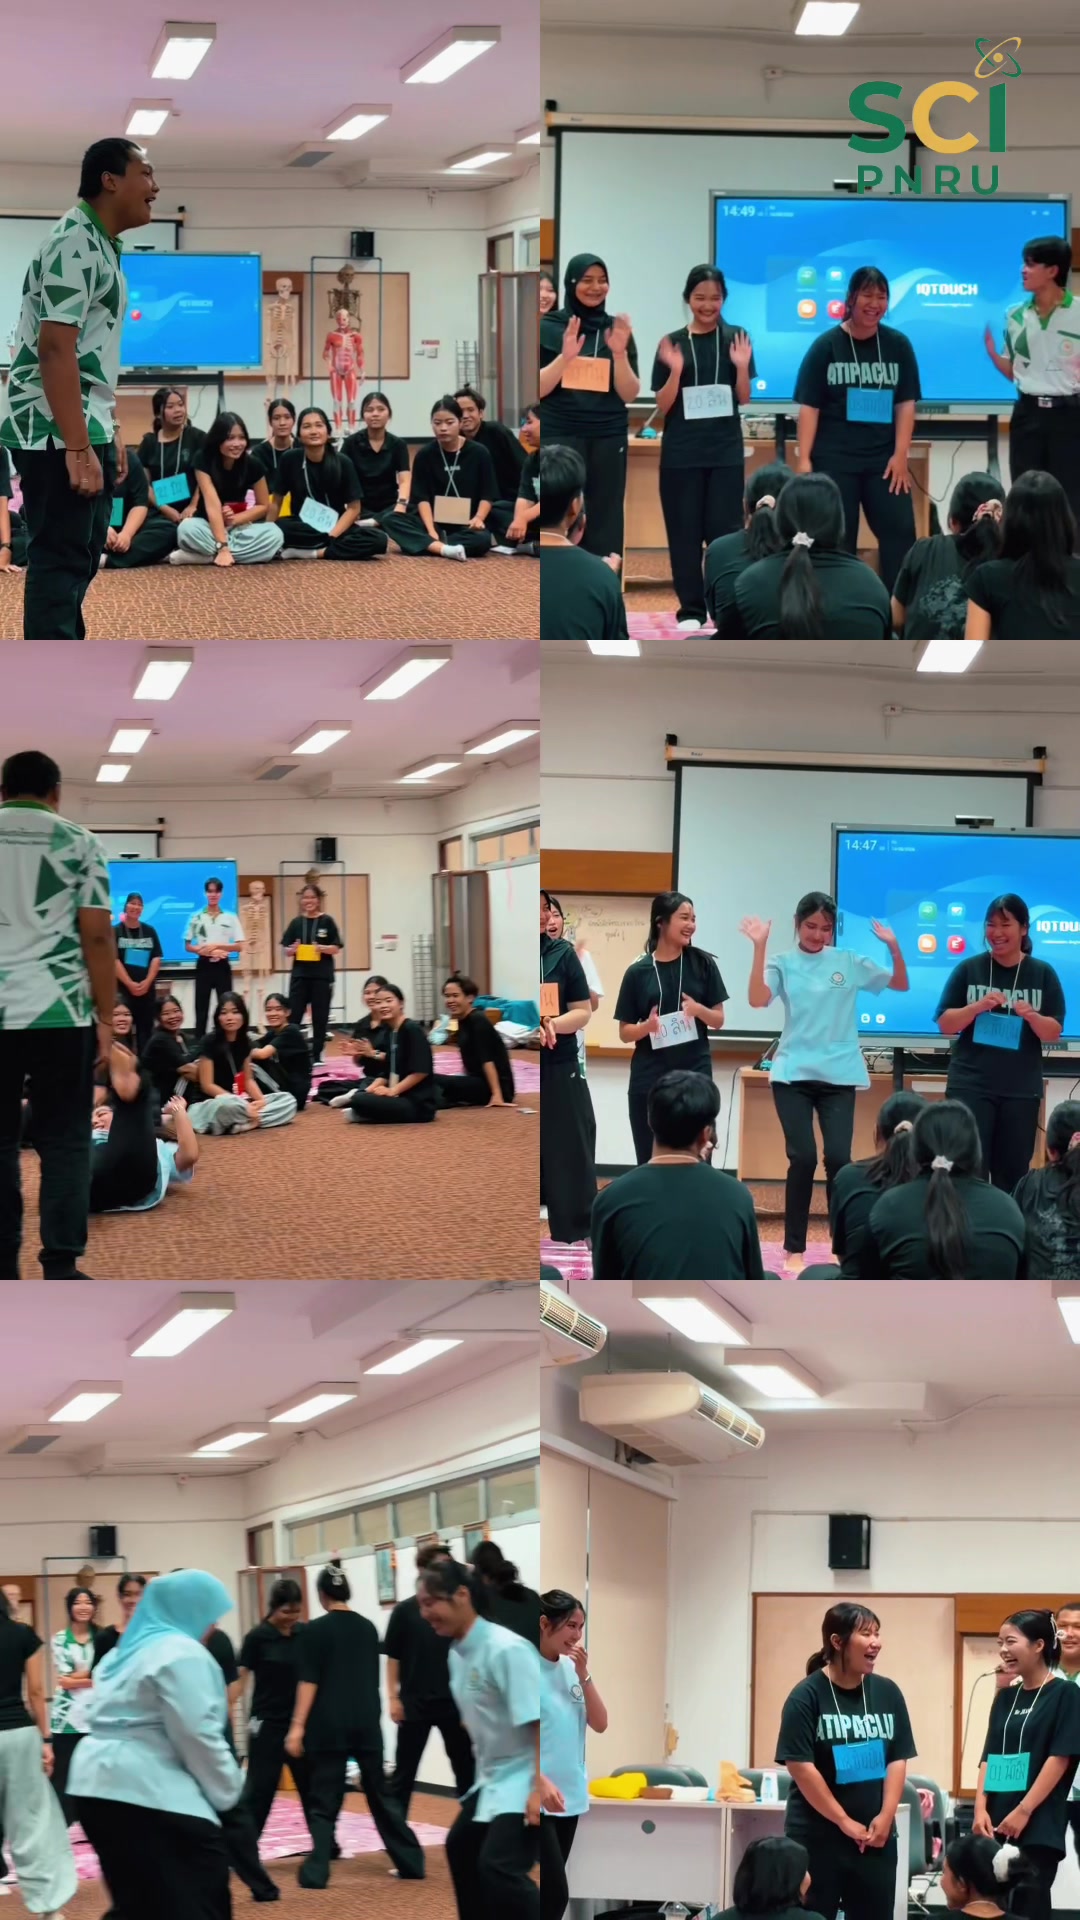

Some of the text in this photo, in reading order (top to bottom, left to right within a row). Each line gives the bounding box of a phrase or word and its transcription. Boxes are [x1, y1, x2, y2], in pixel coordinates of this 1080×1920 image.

[723, 204, 756, 217] 14:49
[916, 283, 978, 296] IQTOUCH
[845, 839, 878, 851] 14:47
[1036, 920, 1080, 933] IQTOU
